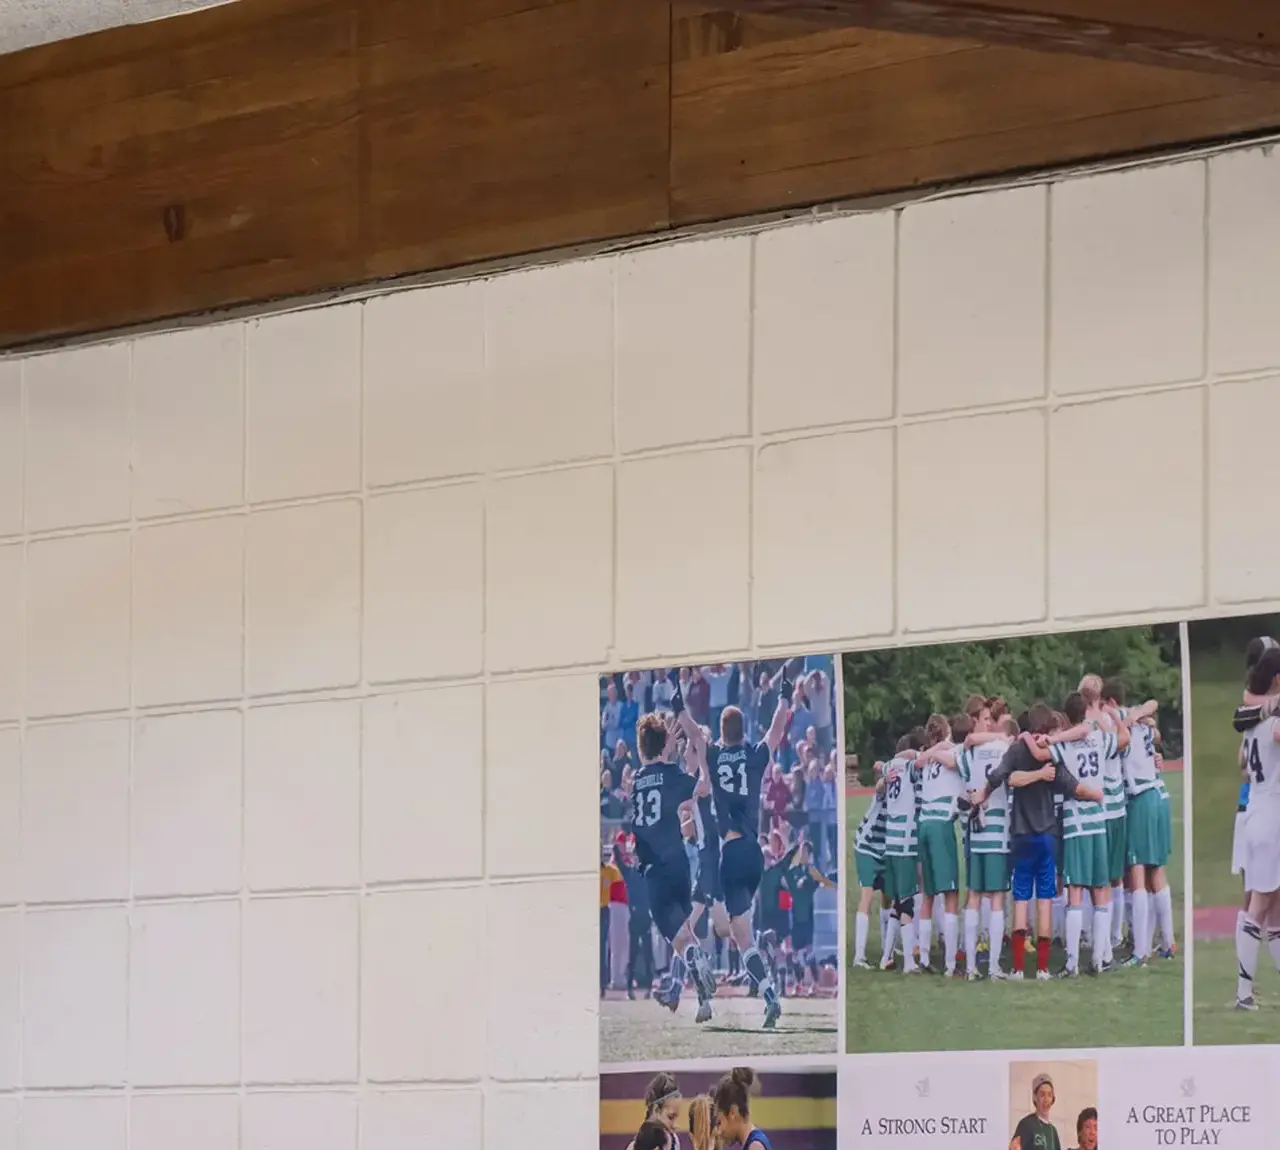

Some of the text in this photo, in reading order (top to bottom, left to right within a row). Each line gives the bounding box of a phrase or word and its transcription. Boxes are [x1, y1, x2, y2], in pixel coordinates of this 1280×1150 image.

[1076, 751, 1099, 778] 29
[718, 763, 748, 795] 21
[635, 789, 661, 827] 13
[861, 1116, 987, 1135] A STRONG START
[1126, 1104, 1251, 1124] A GREAT PLACE
[1155, 1127, 1222, 1144] TO PLAY
